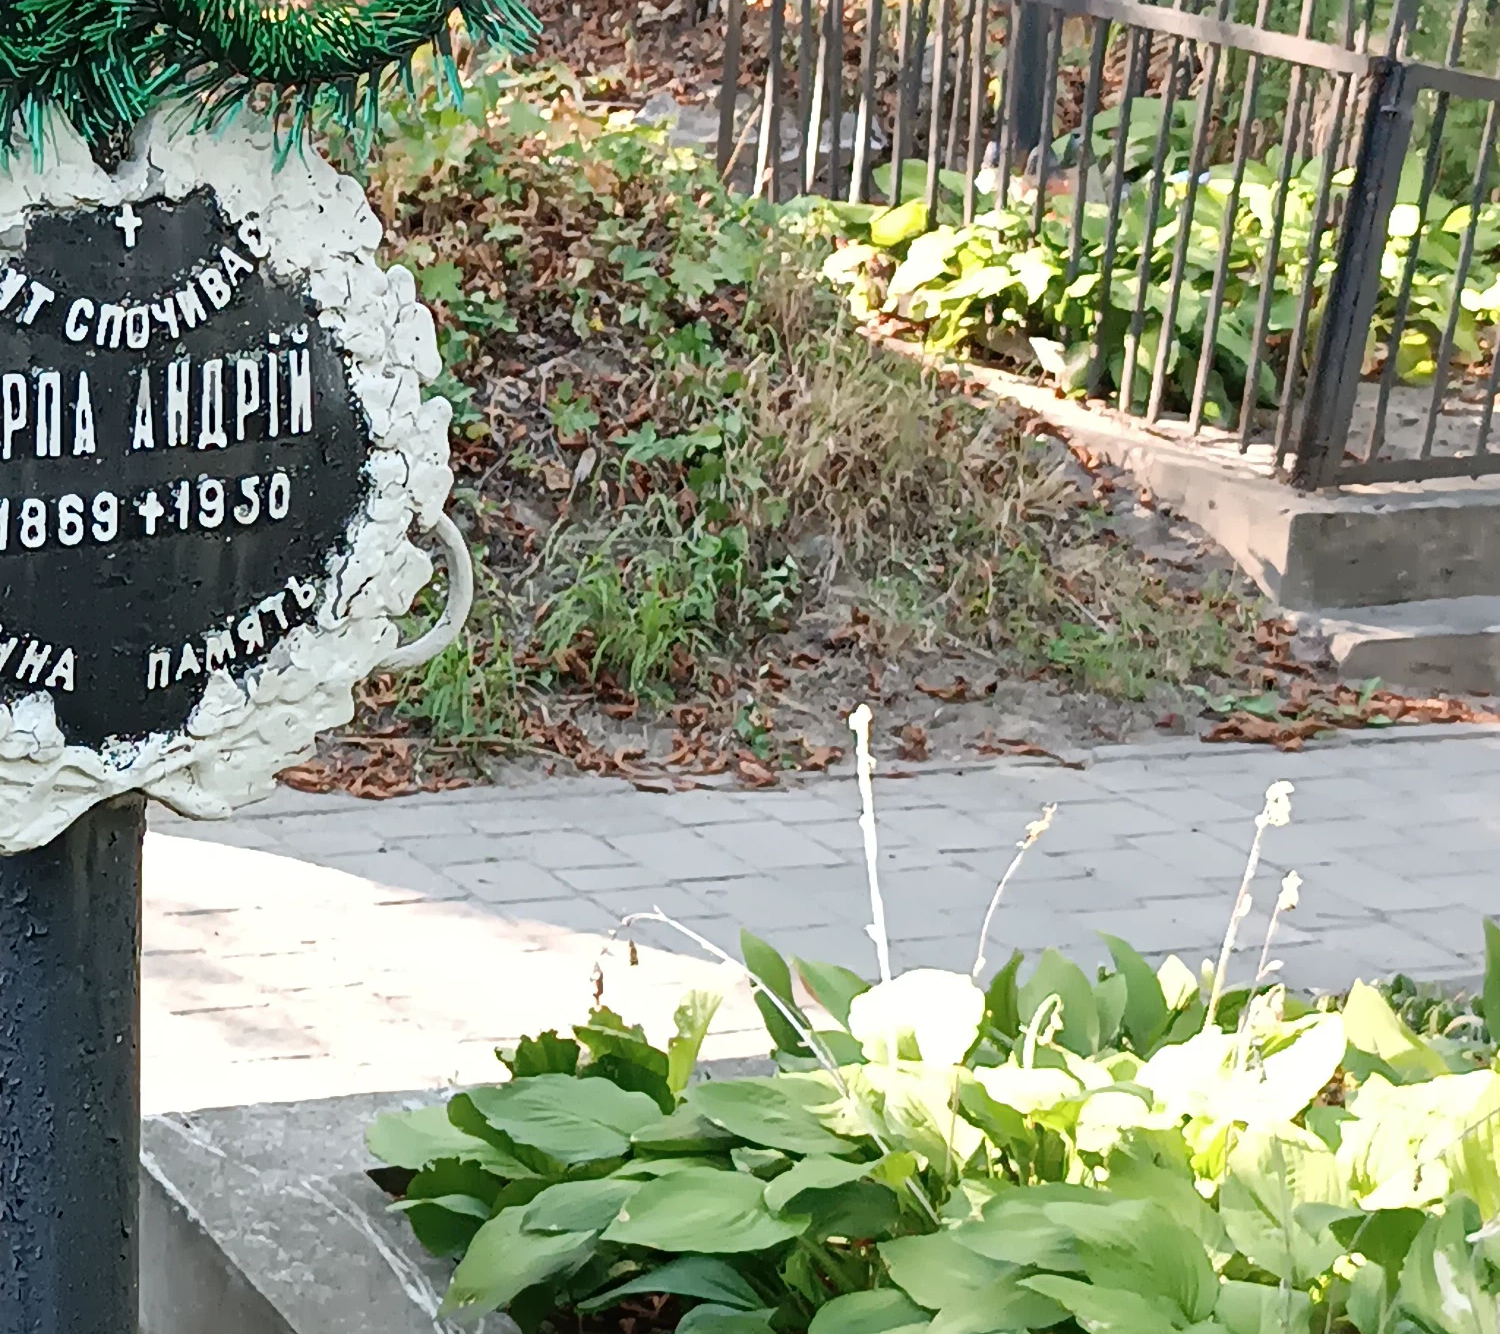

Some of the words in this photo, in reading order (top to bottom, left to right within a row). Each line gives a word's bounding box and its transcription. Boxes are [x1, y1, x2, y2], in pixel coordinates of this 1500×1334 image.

[65, 220, 272, 349] СПОЧИВАЄ
[132, 329, 313, 450] АНДРІЙ
[174, 472, 291, 530] 1950
